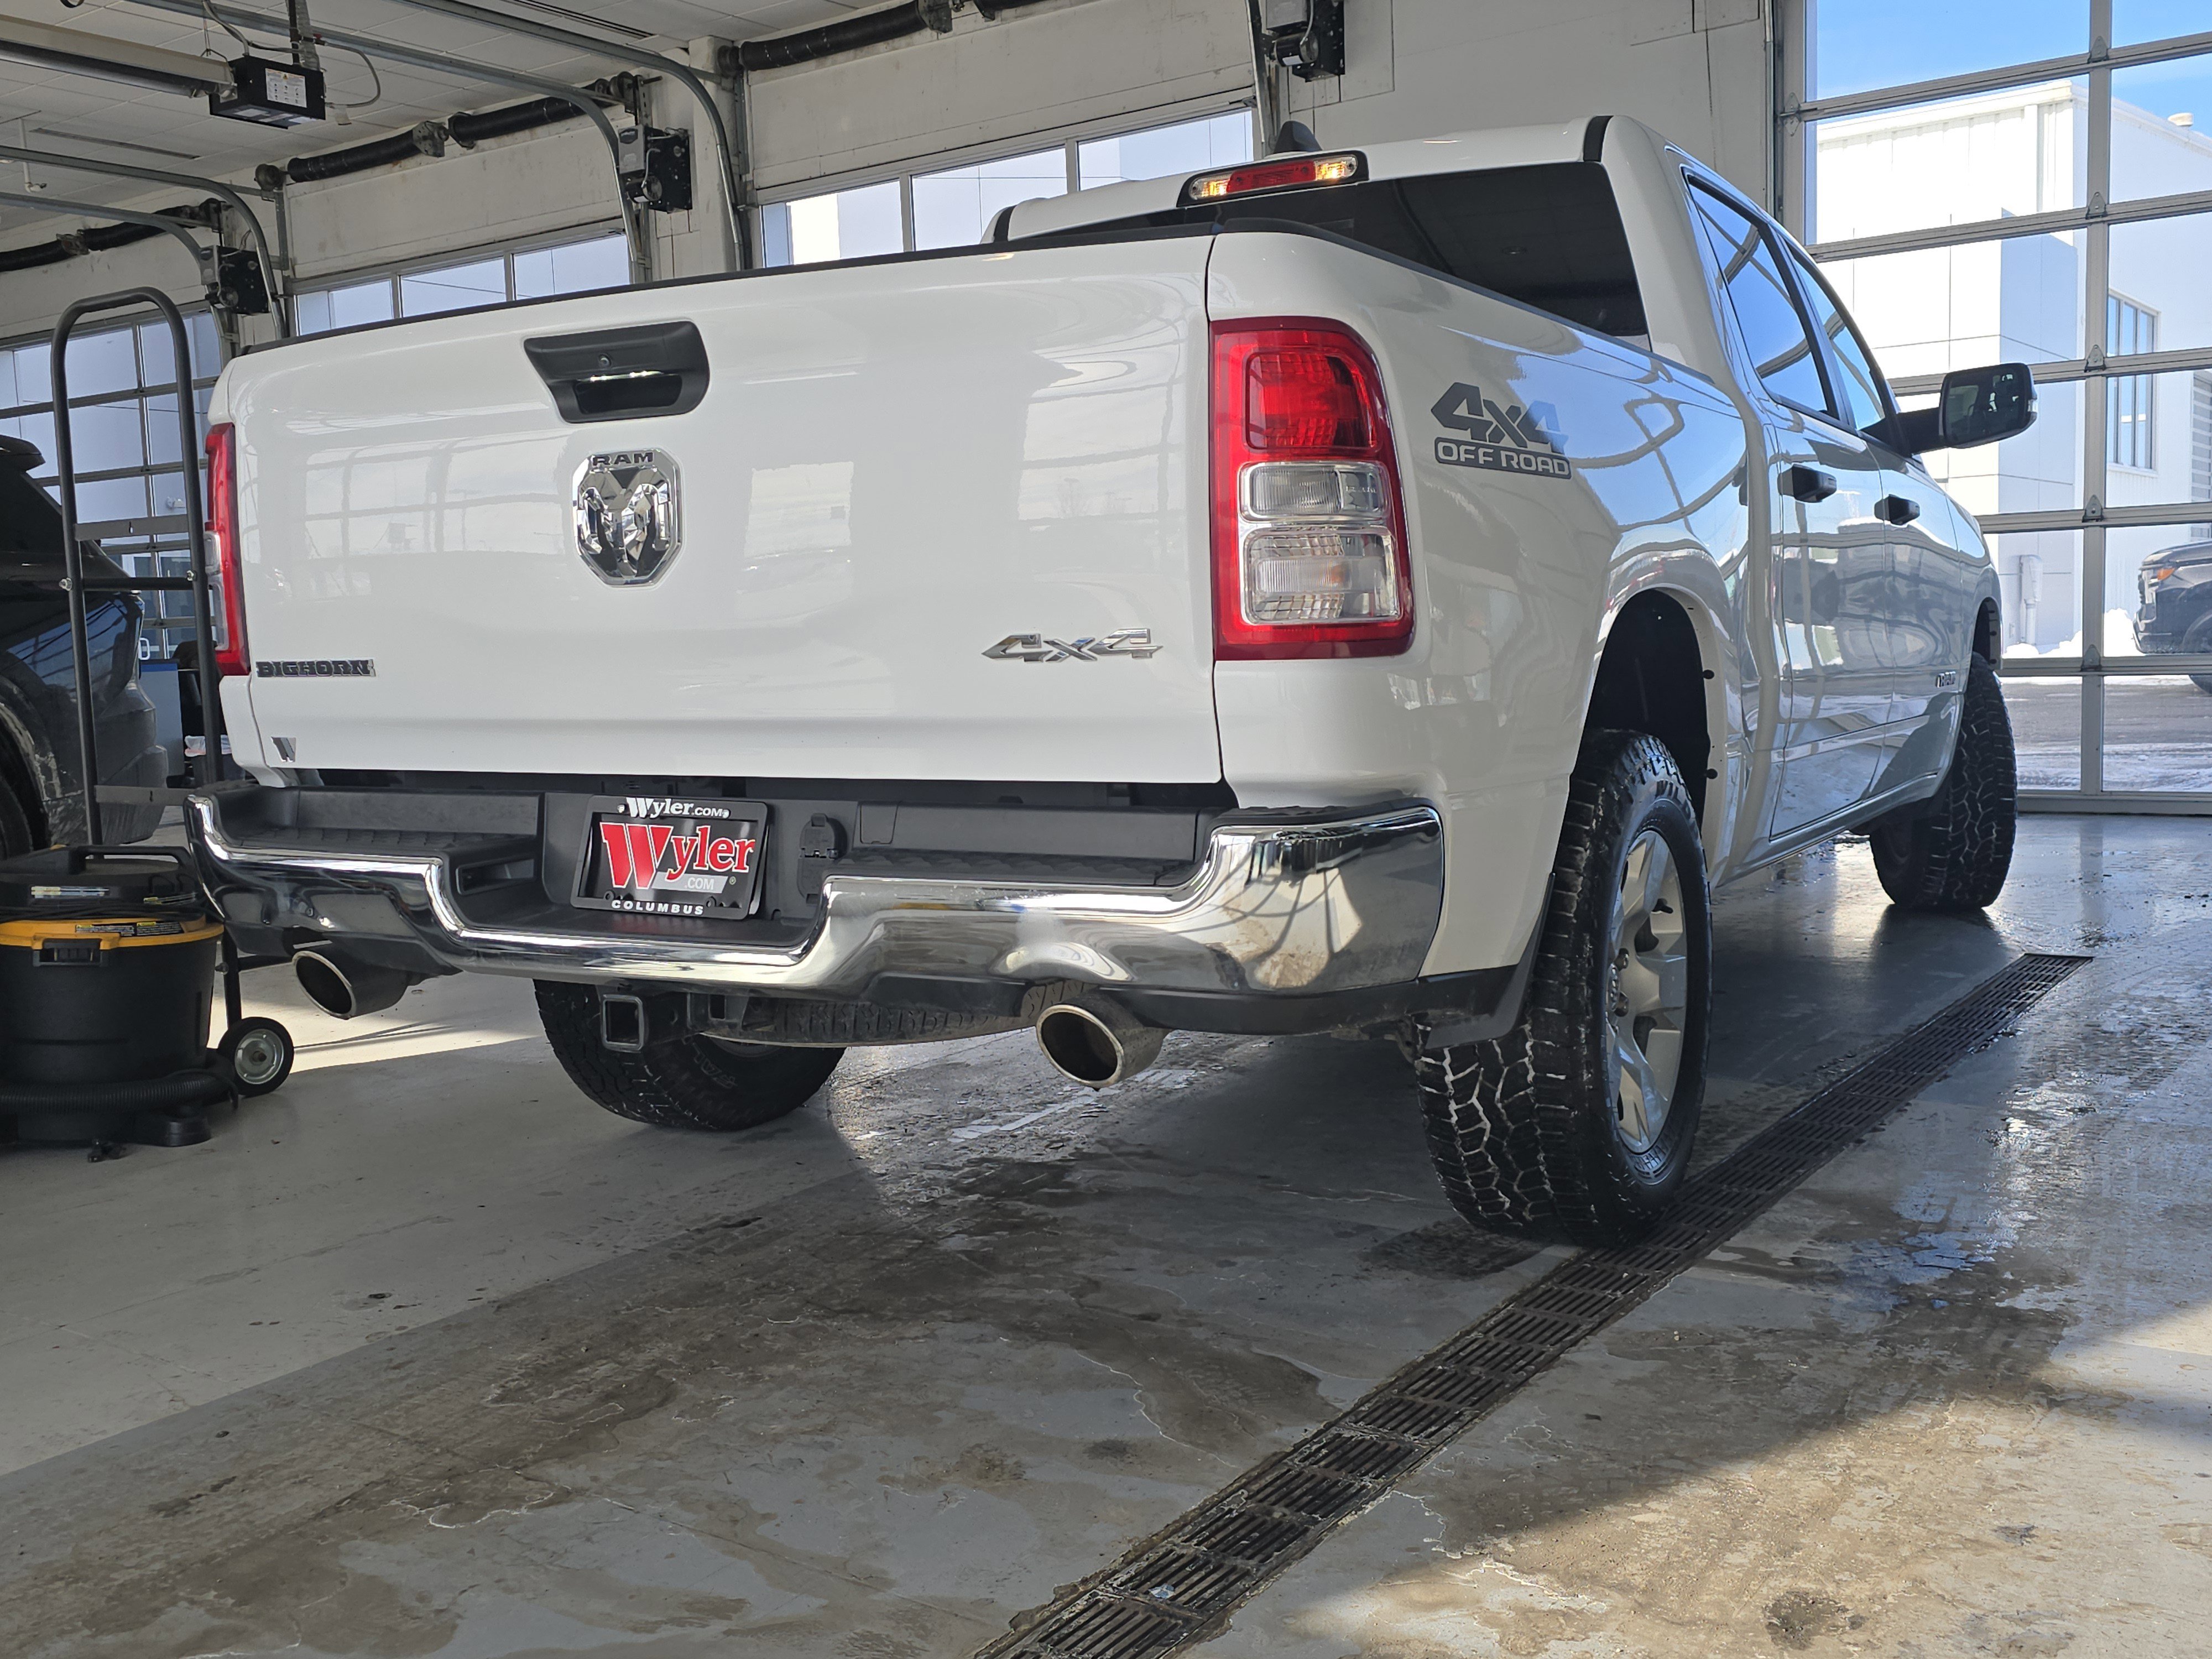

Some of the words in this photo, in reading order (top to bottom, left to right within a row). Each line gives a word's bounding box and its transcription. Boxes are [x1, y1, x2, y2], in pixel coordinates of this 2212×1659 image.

[592, 451, 654, 466] RAM
[1437, 441, 1494, 465] OFF
[1500, 450, 1570, 476] ROAD
[599, 822, 756, 890] Wyler
[685, 877, 714, 891] .COM
[611, 899, 705, 916] COLUMBUS
